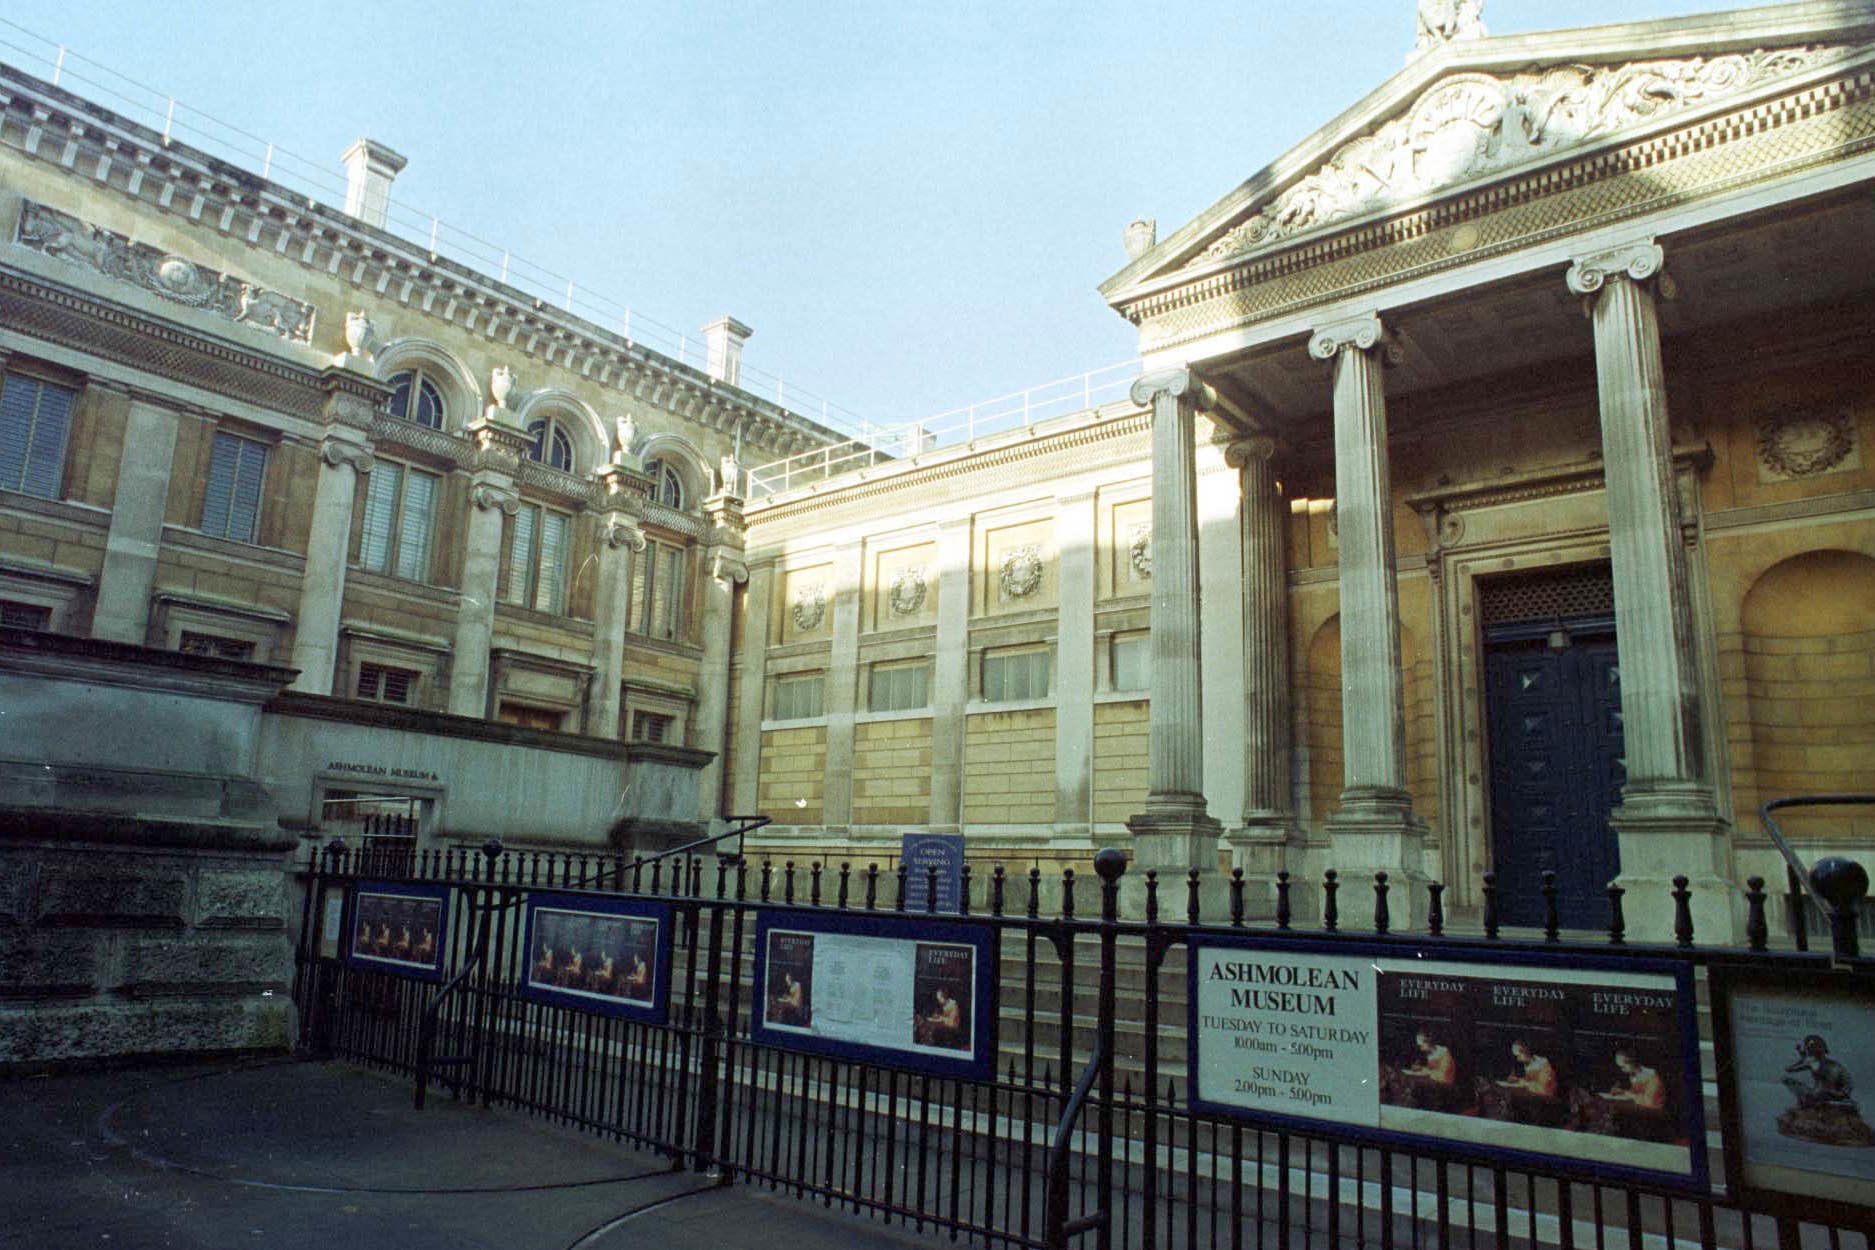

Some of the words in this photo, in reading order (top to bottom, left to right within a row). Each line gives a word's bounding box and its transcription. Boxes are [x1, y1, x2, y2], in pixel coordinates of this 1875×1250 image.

[328, 762, 387, 775] ASHMOLEAN
[390, 767, 430, 780] MUSEUM
[1210, 961, 1360, 991] ASHMOLEAN
[1399, 978, 1466, 994] EVERYDAY
[1399, 988, 1430, 1000] LIFE
[1493, 985, 1566, 1001] EVERYDAY
[1230, 988, 1336, 1016] MUSEUM
[1493, 996, 1527, 1008] LIFE
[1592, 992, 1675, 1009] EVERYDAY
[1592, 1003, 1630, 1016] LIFE
[1201, 1015, 1262, 1034] TUESDAY
[1267, 1021, 1287, 1037] TO
[1290, 1023, 1369, 1045] SATURDAY
[1252, 1066, 1311, 1086] SUNDAY
